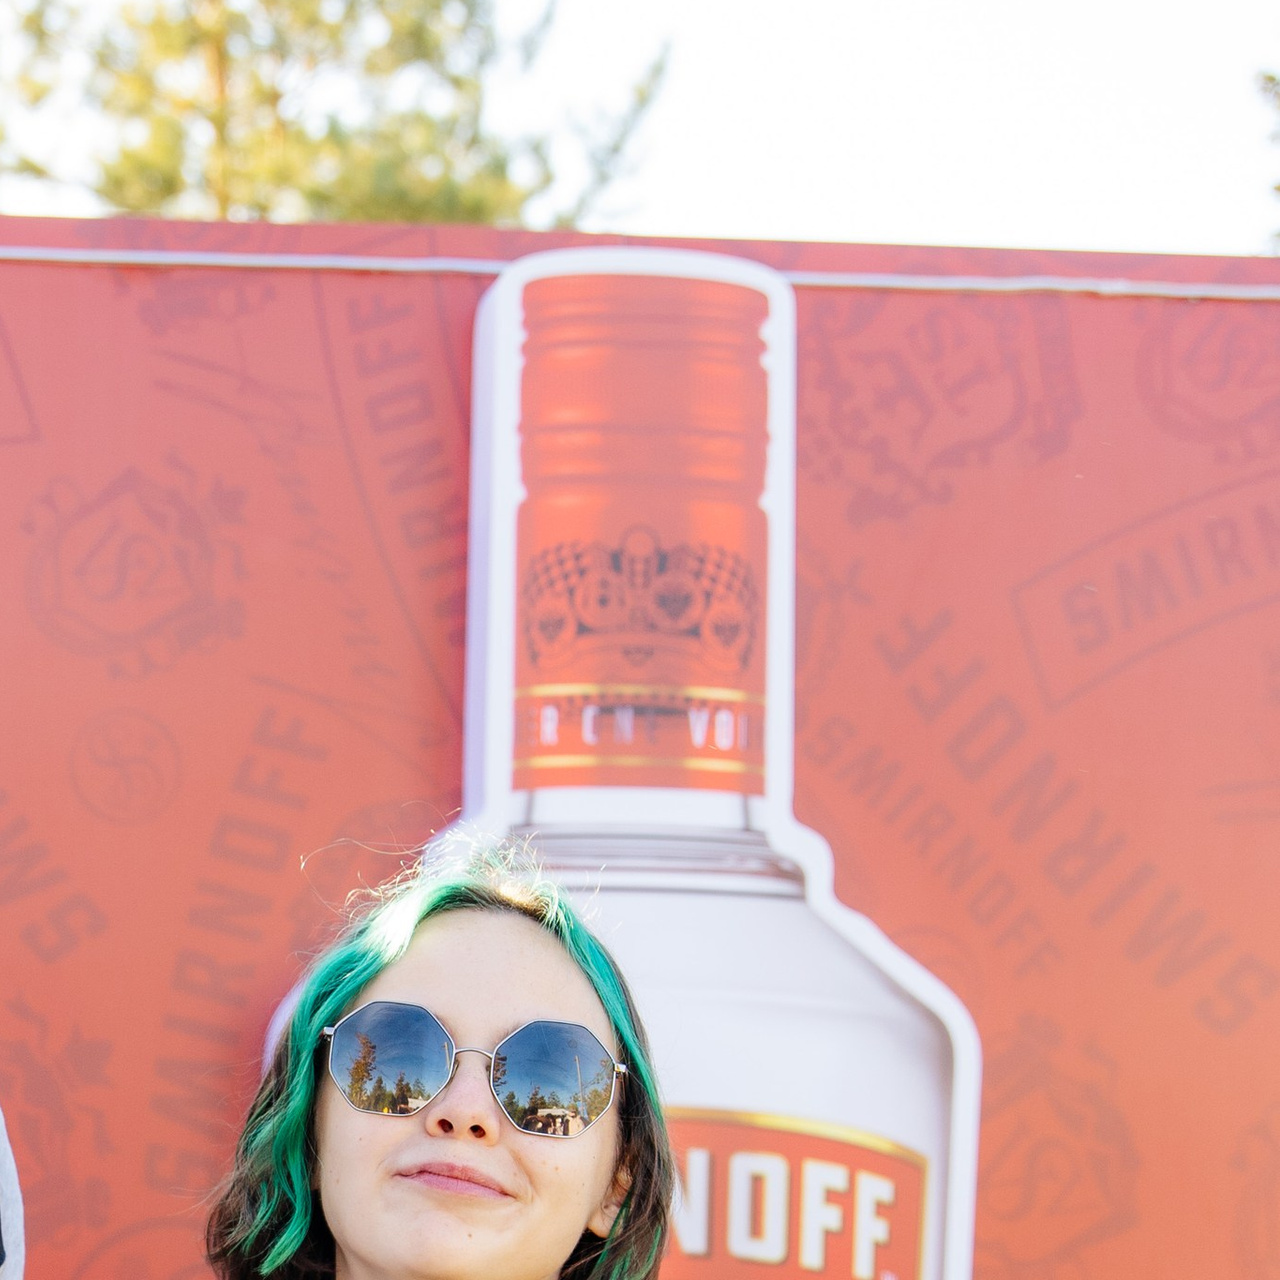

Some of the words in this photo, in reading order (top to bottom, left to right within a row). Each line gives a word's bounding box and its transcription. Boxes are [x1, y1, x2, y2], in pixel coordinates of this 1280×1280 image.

[143, 704, 330, 1197] SMIRNOFF
[801, 712, 1065, 981] SMIRNOFF
[872, 605, 1280, 1037] SMIRNOFF
